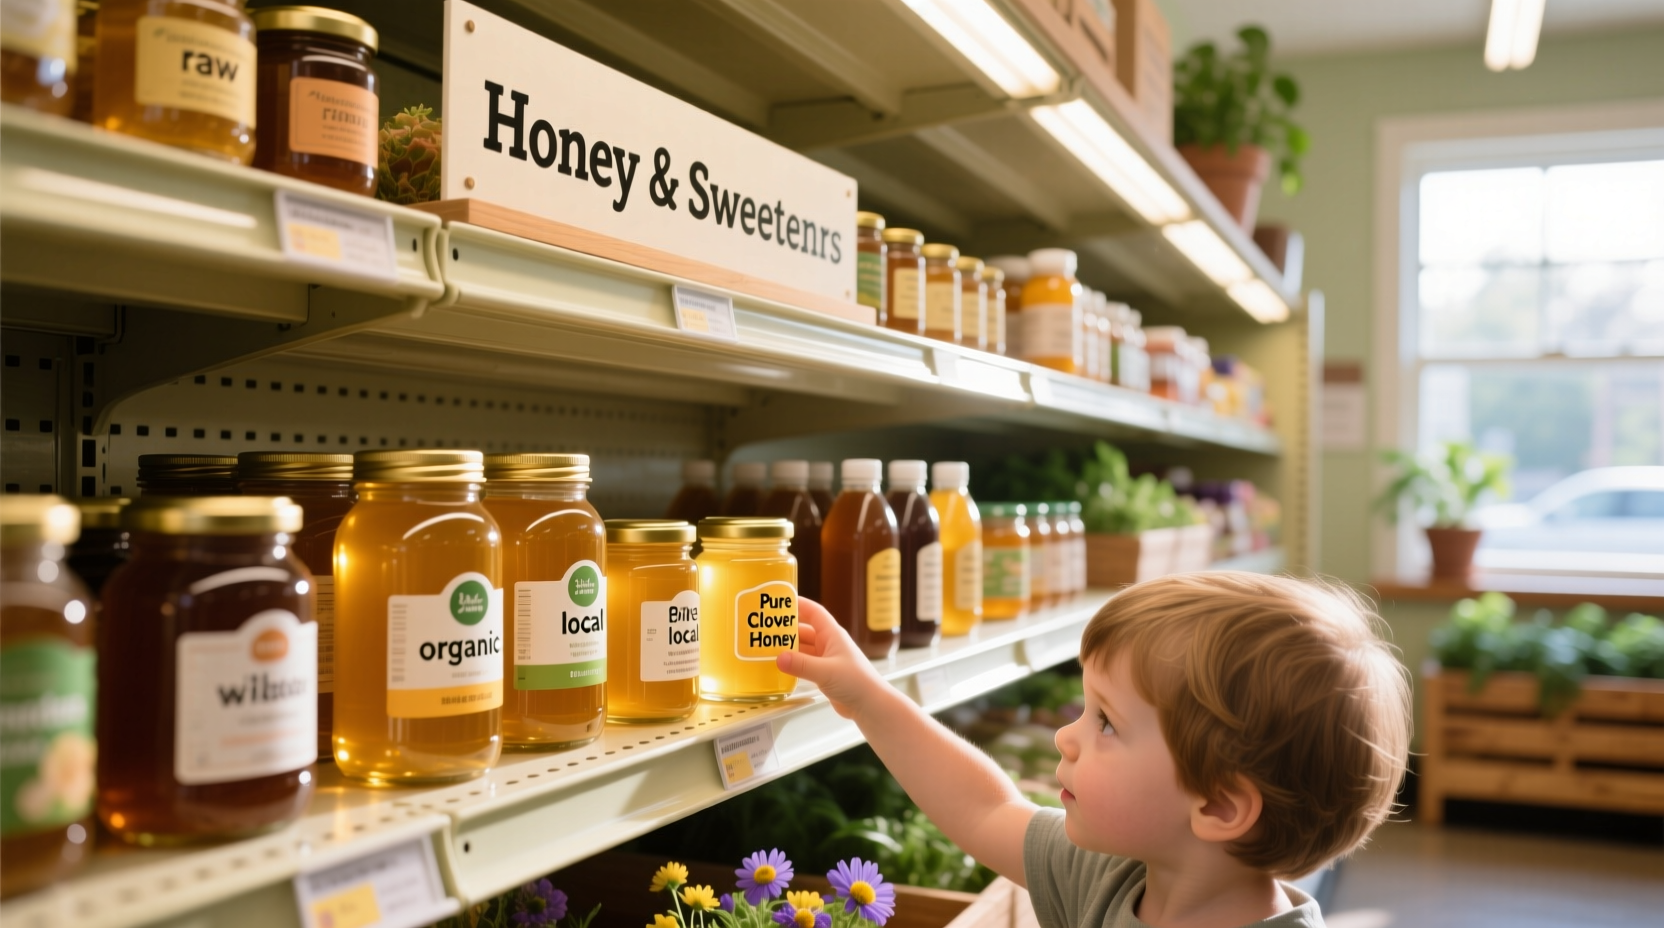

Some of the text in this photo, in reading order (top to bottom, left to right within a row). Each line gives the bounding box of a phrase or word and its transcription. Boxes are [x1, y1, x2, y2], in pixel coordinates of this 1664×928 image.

[181, 48, 240, 83] raw
[483, 79, 843, 265] Honey & Sweetenrs
[759, 593, 792, 609] Pure
[561, 608, 604, 635] local
[747, 611, 796, 629] Clover
[668, 624, 699, 646] local
[749, 631, 797, 650] Honey
[419, 630, 500, 667] organic
